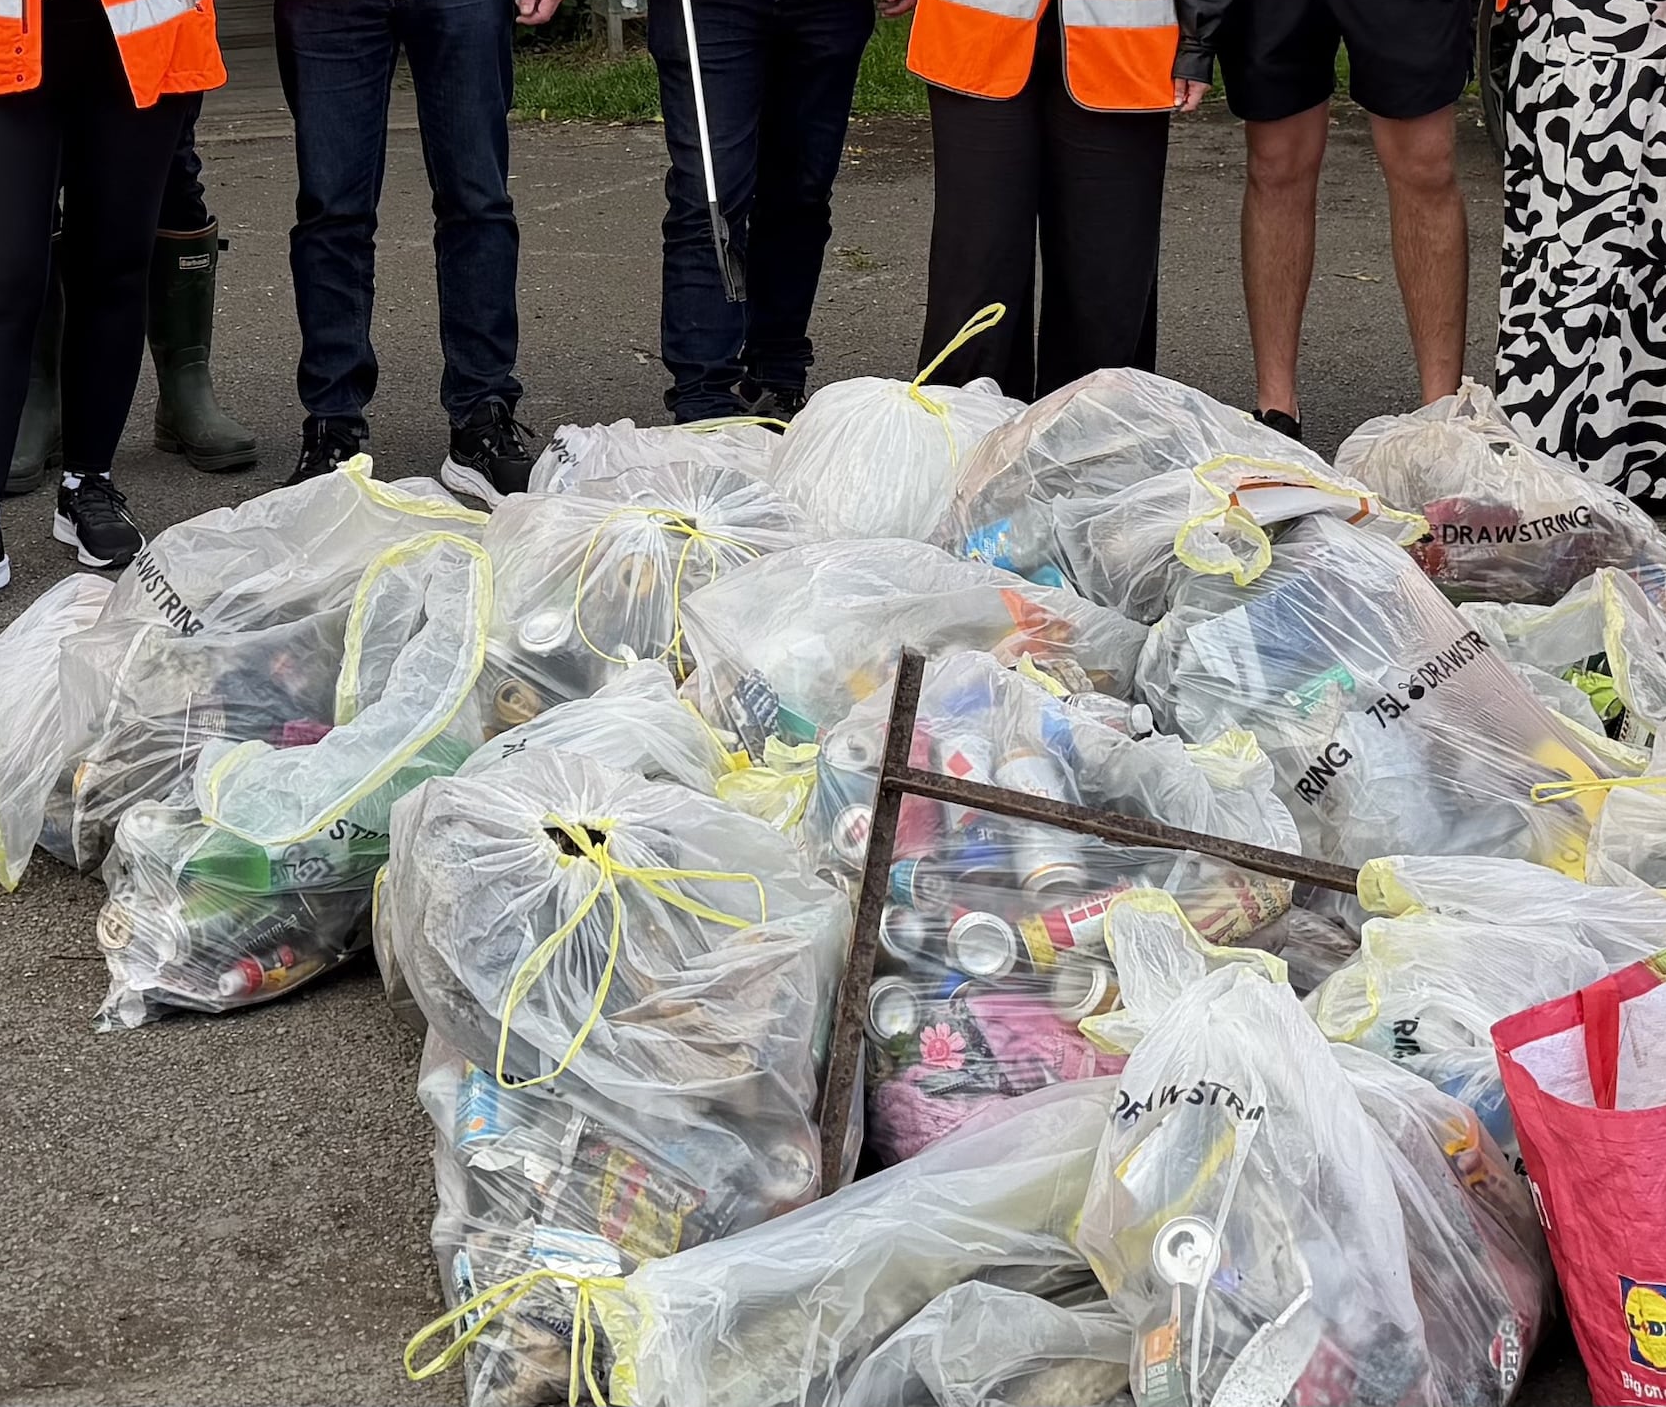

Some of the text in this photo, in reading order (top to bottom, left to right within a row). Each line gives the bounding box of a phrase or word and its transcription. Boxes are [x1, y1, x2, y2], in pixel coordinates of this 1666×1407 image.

[1443, 506, 1591, 545] DRAWSTRING
[1365, 693, 1410, 728] 75L
[1294, 742, 1353, 805] RING
